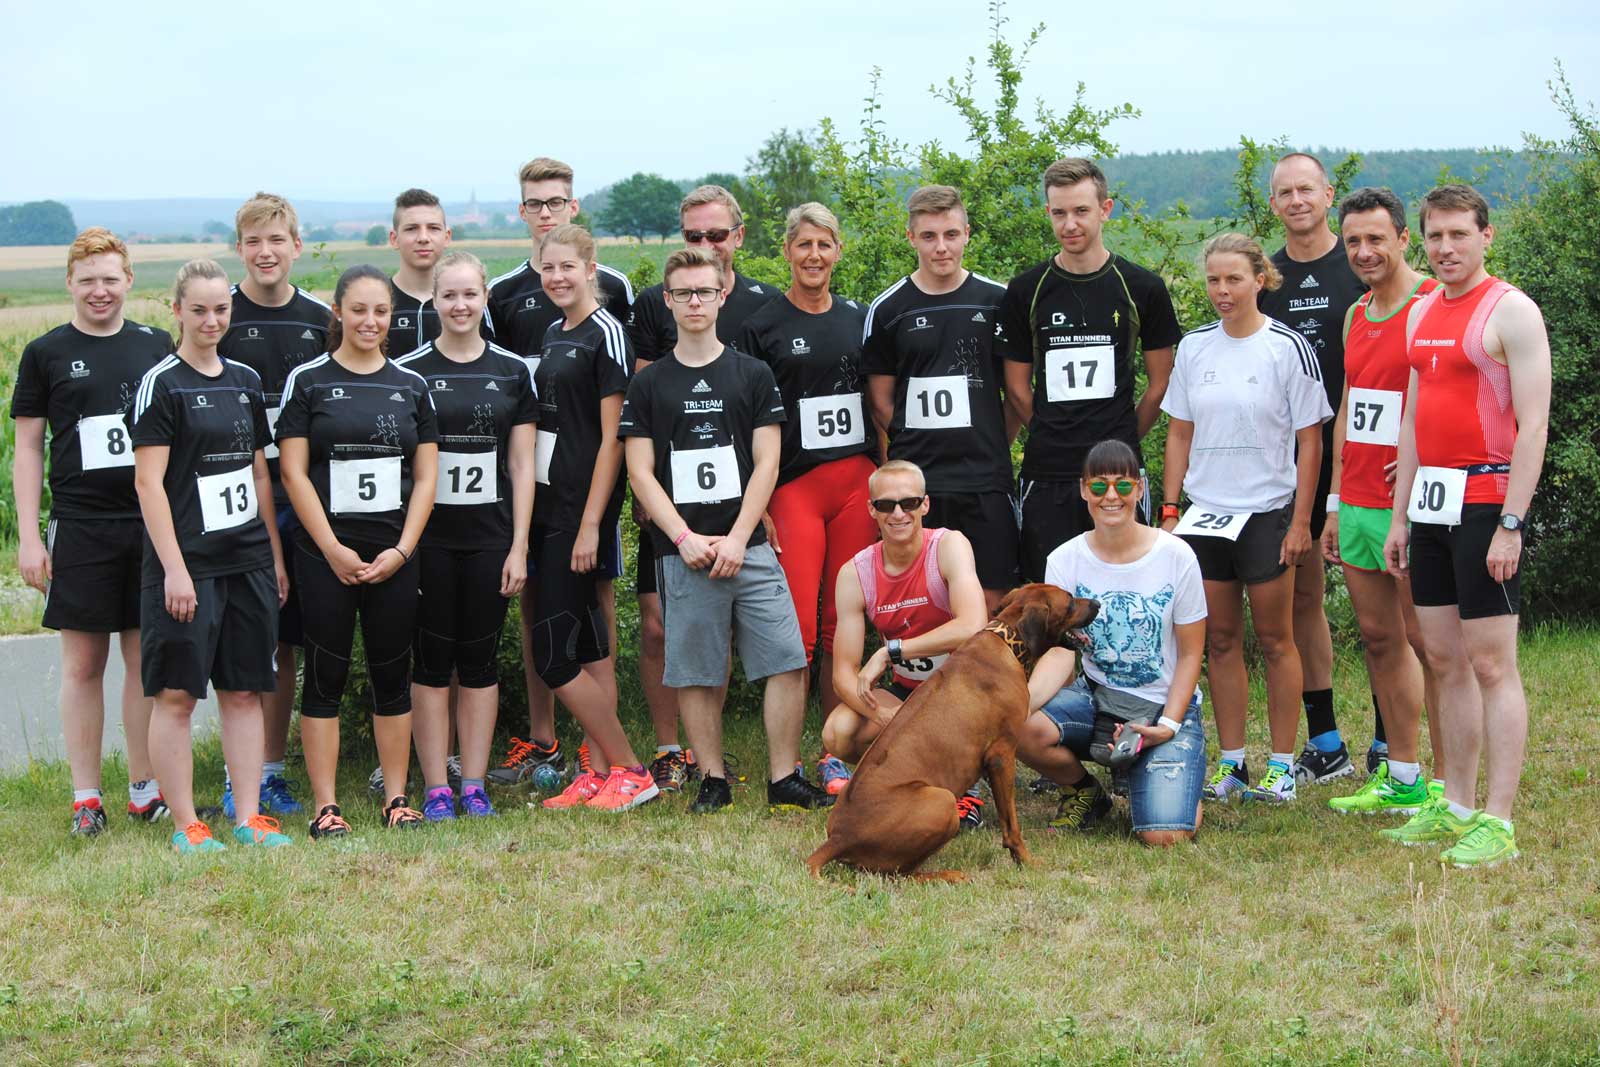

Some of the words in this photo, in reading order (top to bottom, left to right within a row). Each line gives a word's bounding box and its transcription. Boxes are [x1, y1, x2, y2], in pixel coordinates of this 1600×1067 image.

[1289, 296, 1329, 308] TRI-TEAM
[1049, 335, 1072, 343] TITAN
[1073, 334, 1112, 342] RUNNERS
[1062, 360, 1098, 389] 17
[683, 399, 723, 409] TRI-TEAM
[917, 389, 953, 418] 10
[1353, 401, 1384, 432] 57
[817, 407, 852, 437] 59
[107, 427, 126, 455] 8
[358, 472, 377, 501] 5
[447, 466, 483, 494] 12
[696, 461, 717, 490] 6
[219, 482, 248, 516] 13
[1417, 480, 1446, 512] 30
[1192, 512, 1234, 530] 29
[877, 603, 897, 612] TITAN
